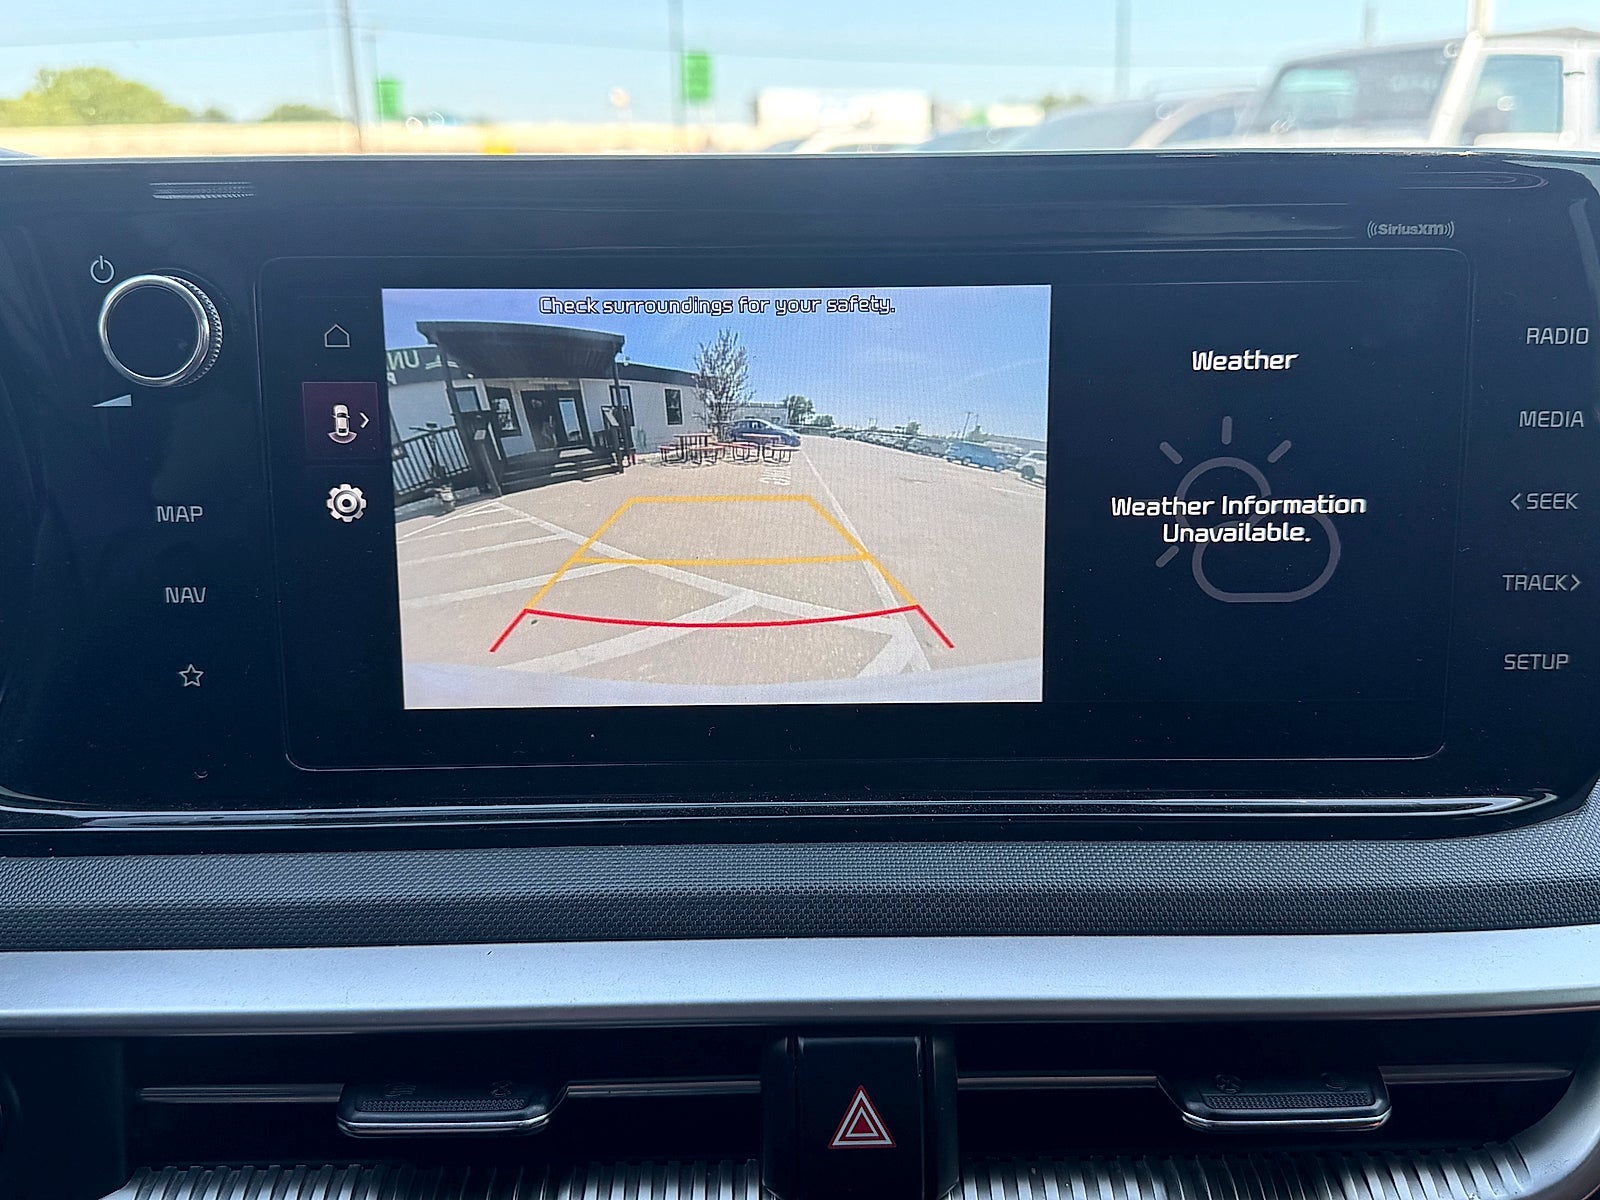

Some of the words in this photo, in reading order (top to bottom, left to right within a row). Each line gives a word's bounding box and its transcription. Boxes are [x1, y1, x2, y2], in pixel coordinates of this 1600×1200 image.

[539, 296, 600, 314] Check
[602, 296, 733, 316] surroundings
[738, 296, 770, 314] for
[775, 298, 821, 316] your
[826, 295, 896, 315] safety.
[1526, 327, 1589, 345] RADIO
[1192, 349, 1299, 371] Weather
[1519, 410, 1585, 428] MEDIA
[1111, 496, 1215, 516] Weather
[1221, 494, 1367, 515] Information
[1526, 492, 1579, 510] SEEK
[156, 505, 204, 523] MAP
[1163, 522, 1311, 543] Unavailable.
[1502, 574, 1567, 591] TRACK
[165, 586, 207, 604] NAV
[1503, 653, 1570, 671] SETUP
